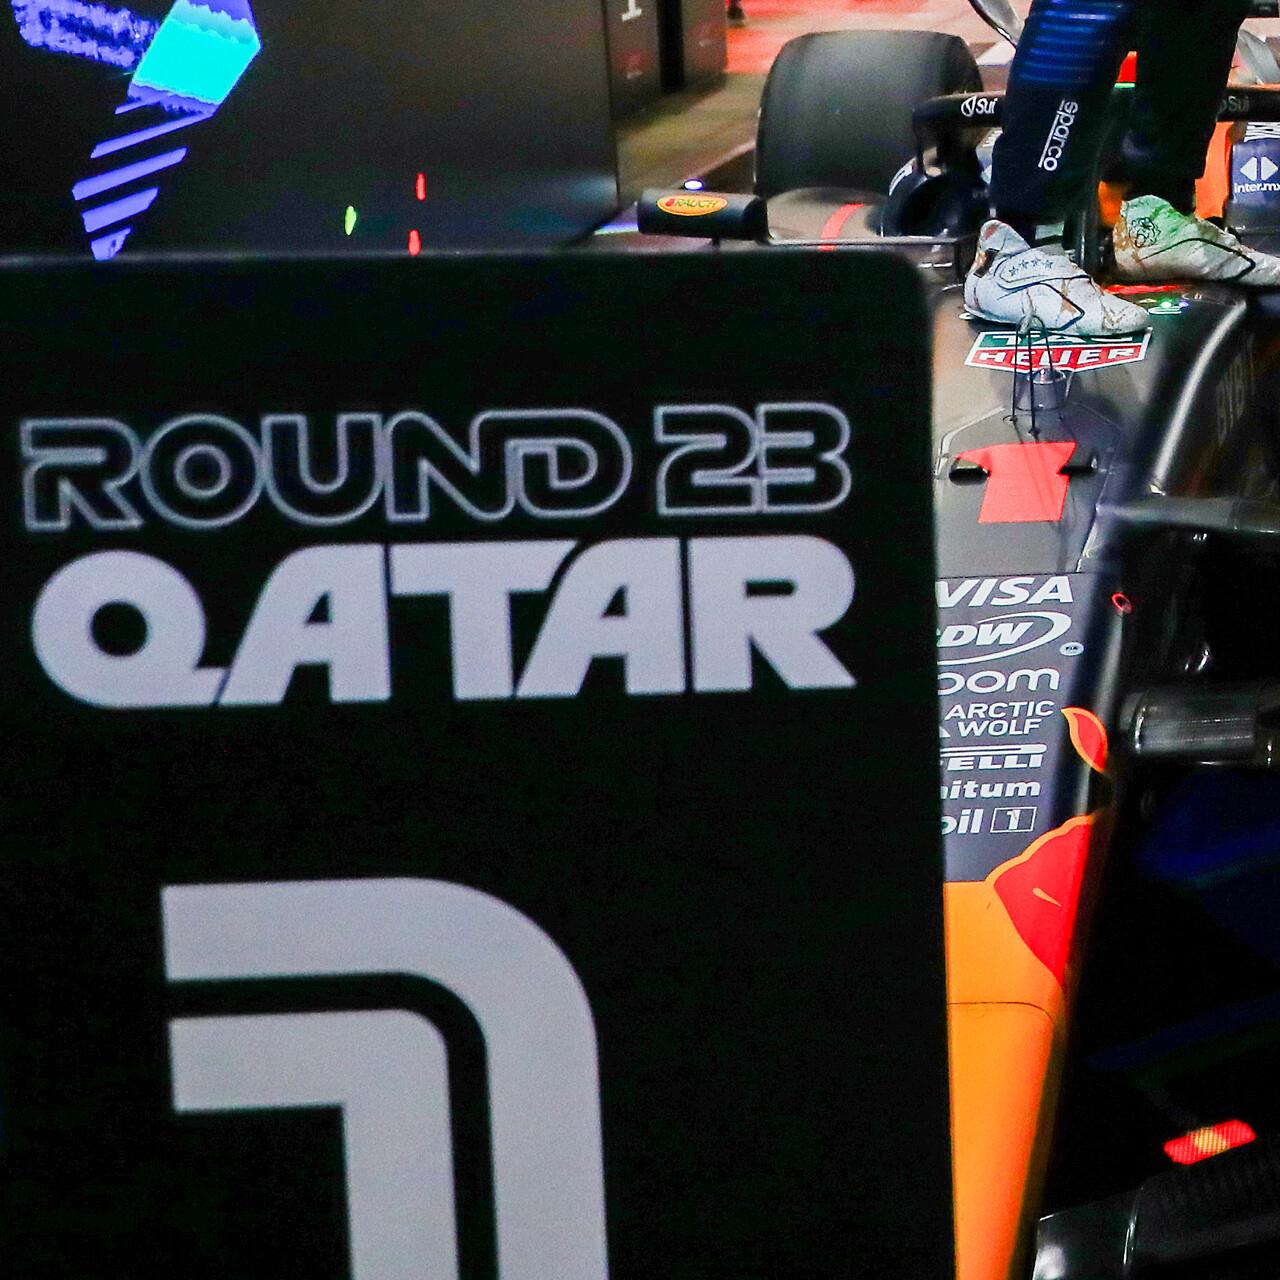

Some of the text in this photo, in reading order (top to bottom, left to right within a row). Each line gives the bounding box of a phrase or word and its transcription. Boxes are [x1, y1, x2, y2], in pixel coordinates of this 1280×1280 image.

[975, 97, 998, 116] Sui
[1038, 99, 1079, 171] sparco
[977, 348, 1136, 367] HEUER
[20, 402, 853, 530] ROUND 23
[935, 576, 1074, 608] VISA
[31, 534, 857, 709] QATAR
[936, 621, 1034, 648] DW
[938, 668, 1060, 696] oom
[944, 701, 1056, 721] ARCTIC
[958, 718, 1043, 738] WOLF
[941, 744, 1047, 771] ELLI
